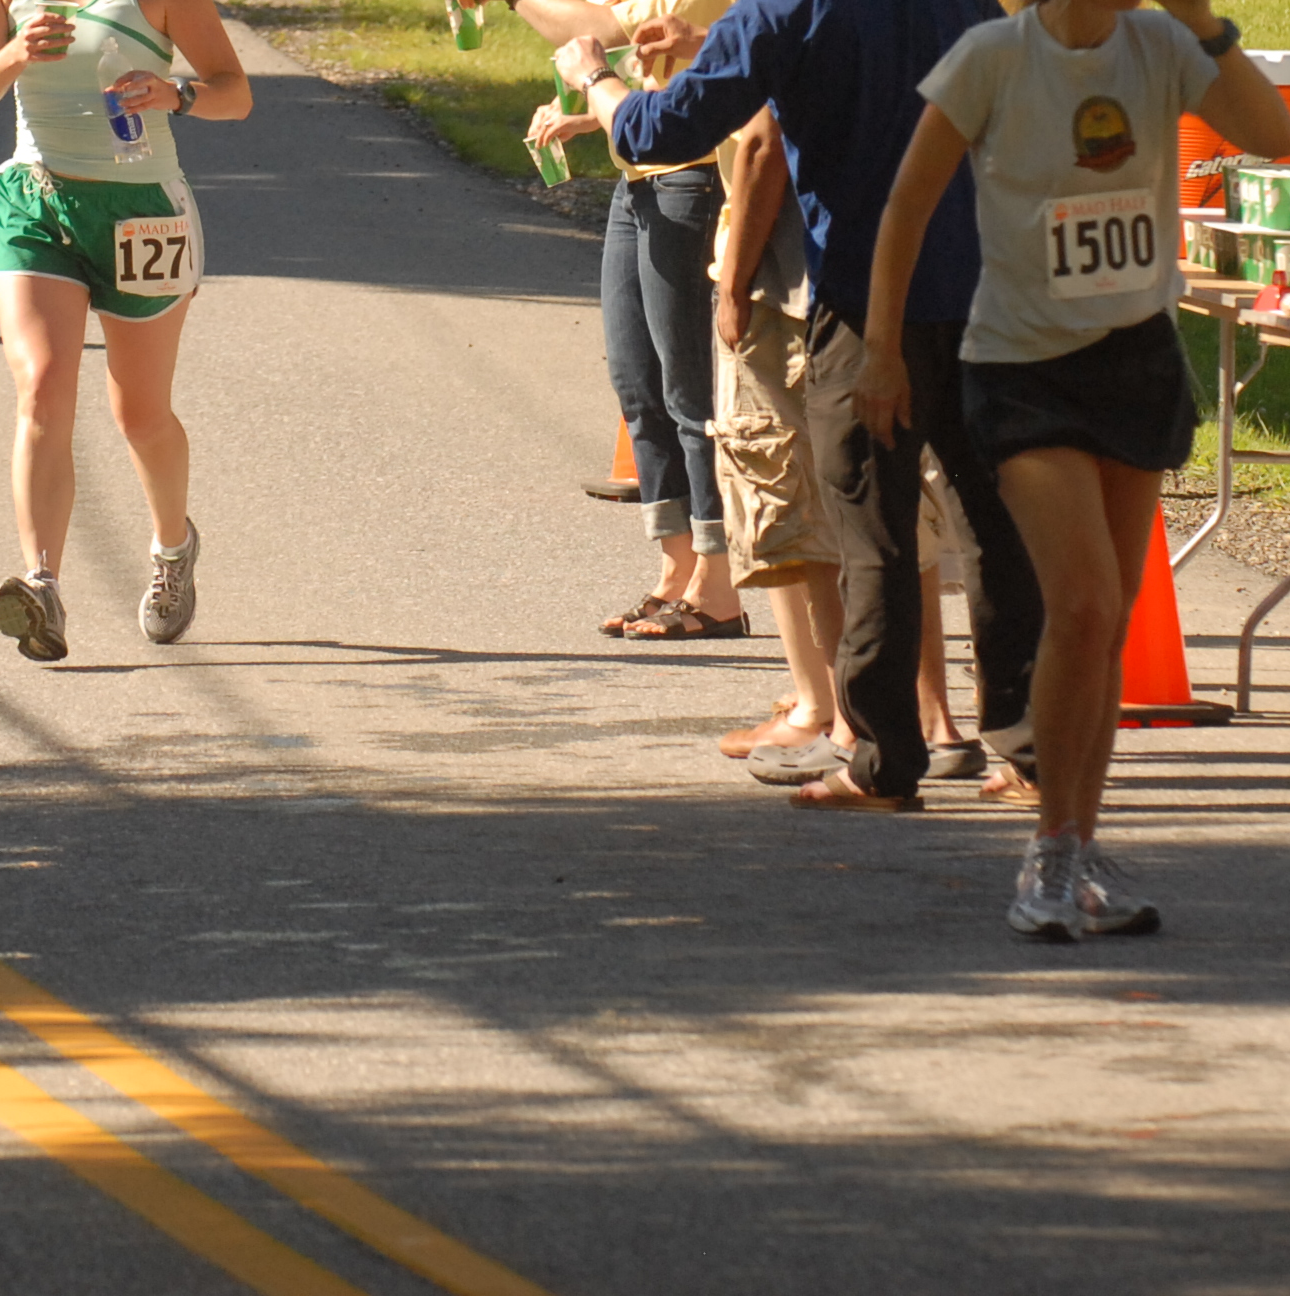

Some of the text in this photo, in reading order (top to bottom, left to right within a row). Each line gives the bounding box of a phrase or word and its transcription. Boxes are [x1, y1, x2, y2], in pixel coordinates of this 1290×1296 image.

[138, 224, 169, 235] MAD
[1052, 214, 1155, 277] 1500
[119, 235, 193, 282] 127
